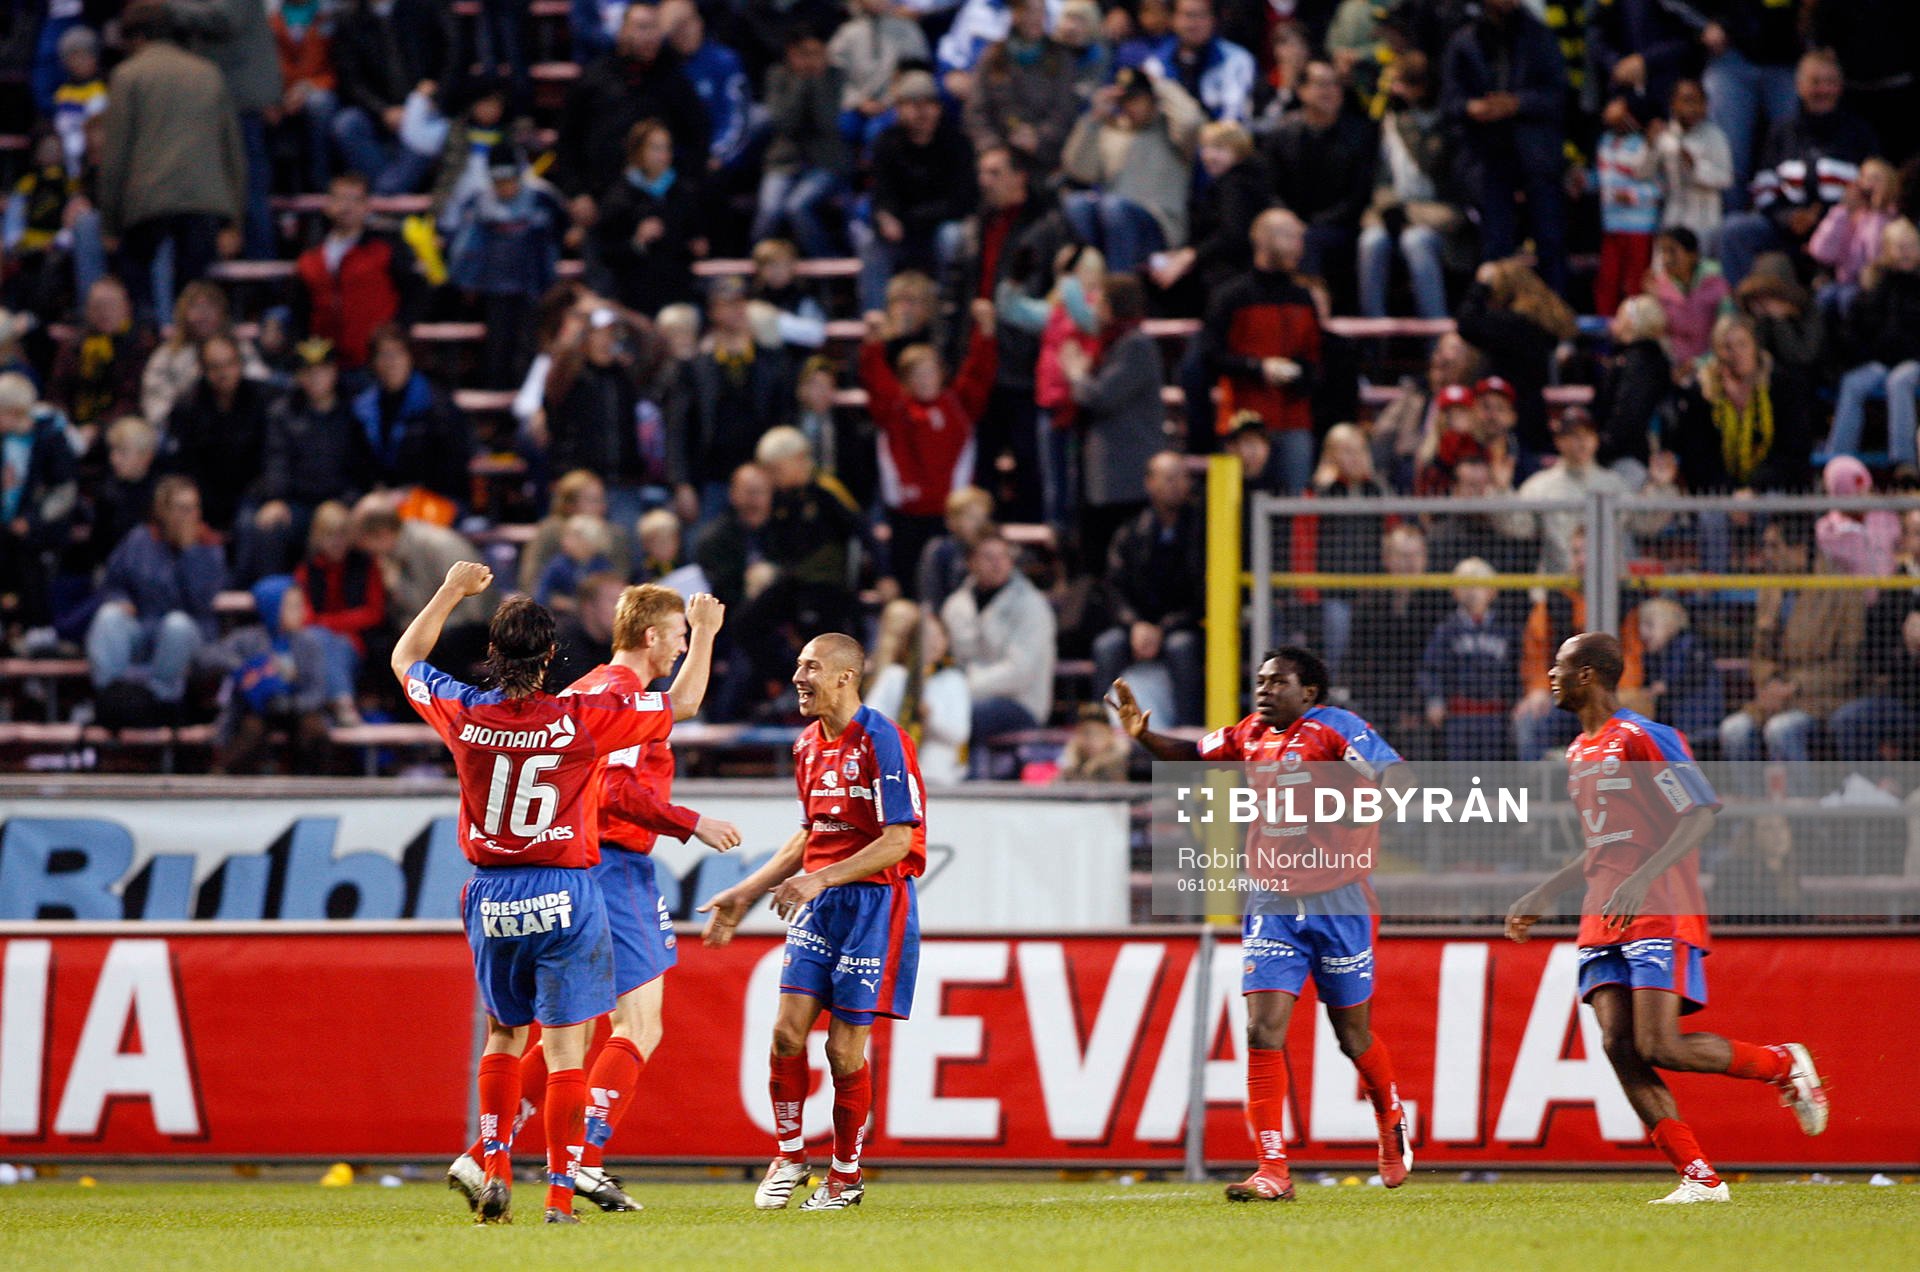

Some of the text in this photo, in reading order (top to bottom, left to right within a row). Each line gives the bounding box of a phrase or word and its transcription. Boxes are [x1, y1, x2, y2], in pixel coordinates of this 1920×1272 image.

[459, 723, 547, 749] BIOMAIN
[484, 752, 563, 838] 16
[480, 890, 571, 916] ÖRESUNDS
[481, 904, 572, 938] KRAFT
